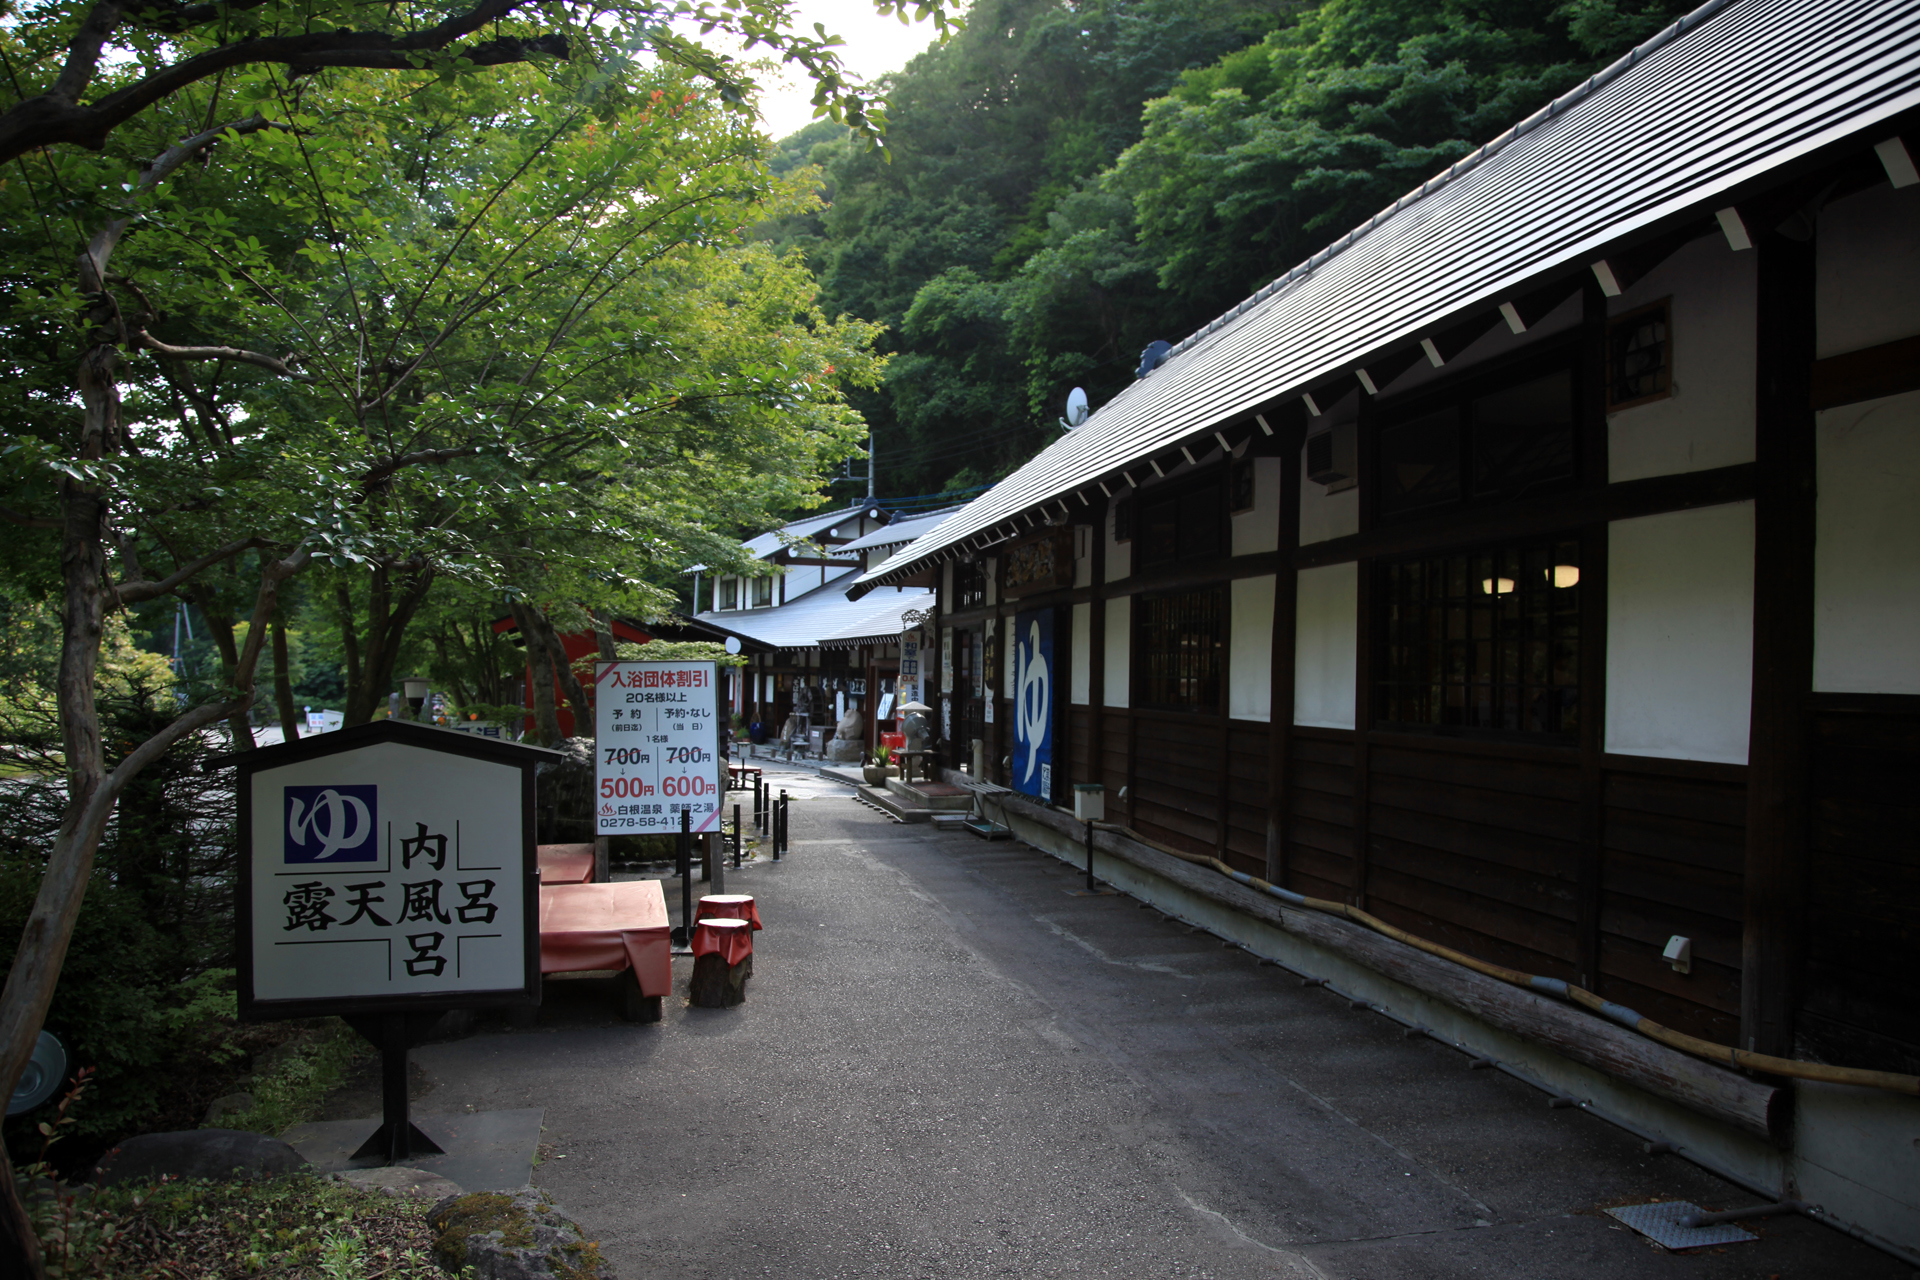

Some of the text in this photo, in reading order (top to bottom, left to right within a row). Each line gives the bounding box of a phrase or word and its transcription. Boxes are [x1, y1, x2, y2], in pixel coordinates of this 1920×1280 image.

[610, 670, 708, 688] 入浴団体割引
[626, 692, 688, 703] 20名様以上
[1016, 619, 1049, 785] ゆ
[646, 735, 669, 743] 1名様
[604, 748, 650, 765] 700円
[666, 746, 711, 764] 700円
[600, 777, 654, 799] 500円
[662, 776, 716, 797] 600円
[617, 803, 714, 815] 白根温泉 薬師之湯
[289, 789, 371, 859] ゆ
[282, 879, 499, 932] 露天風呂
